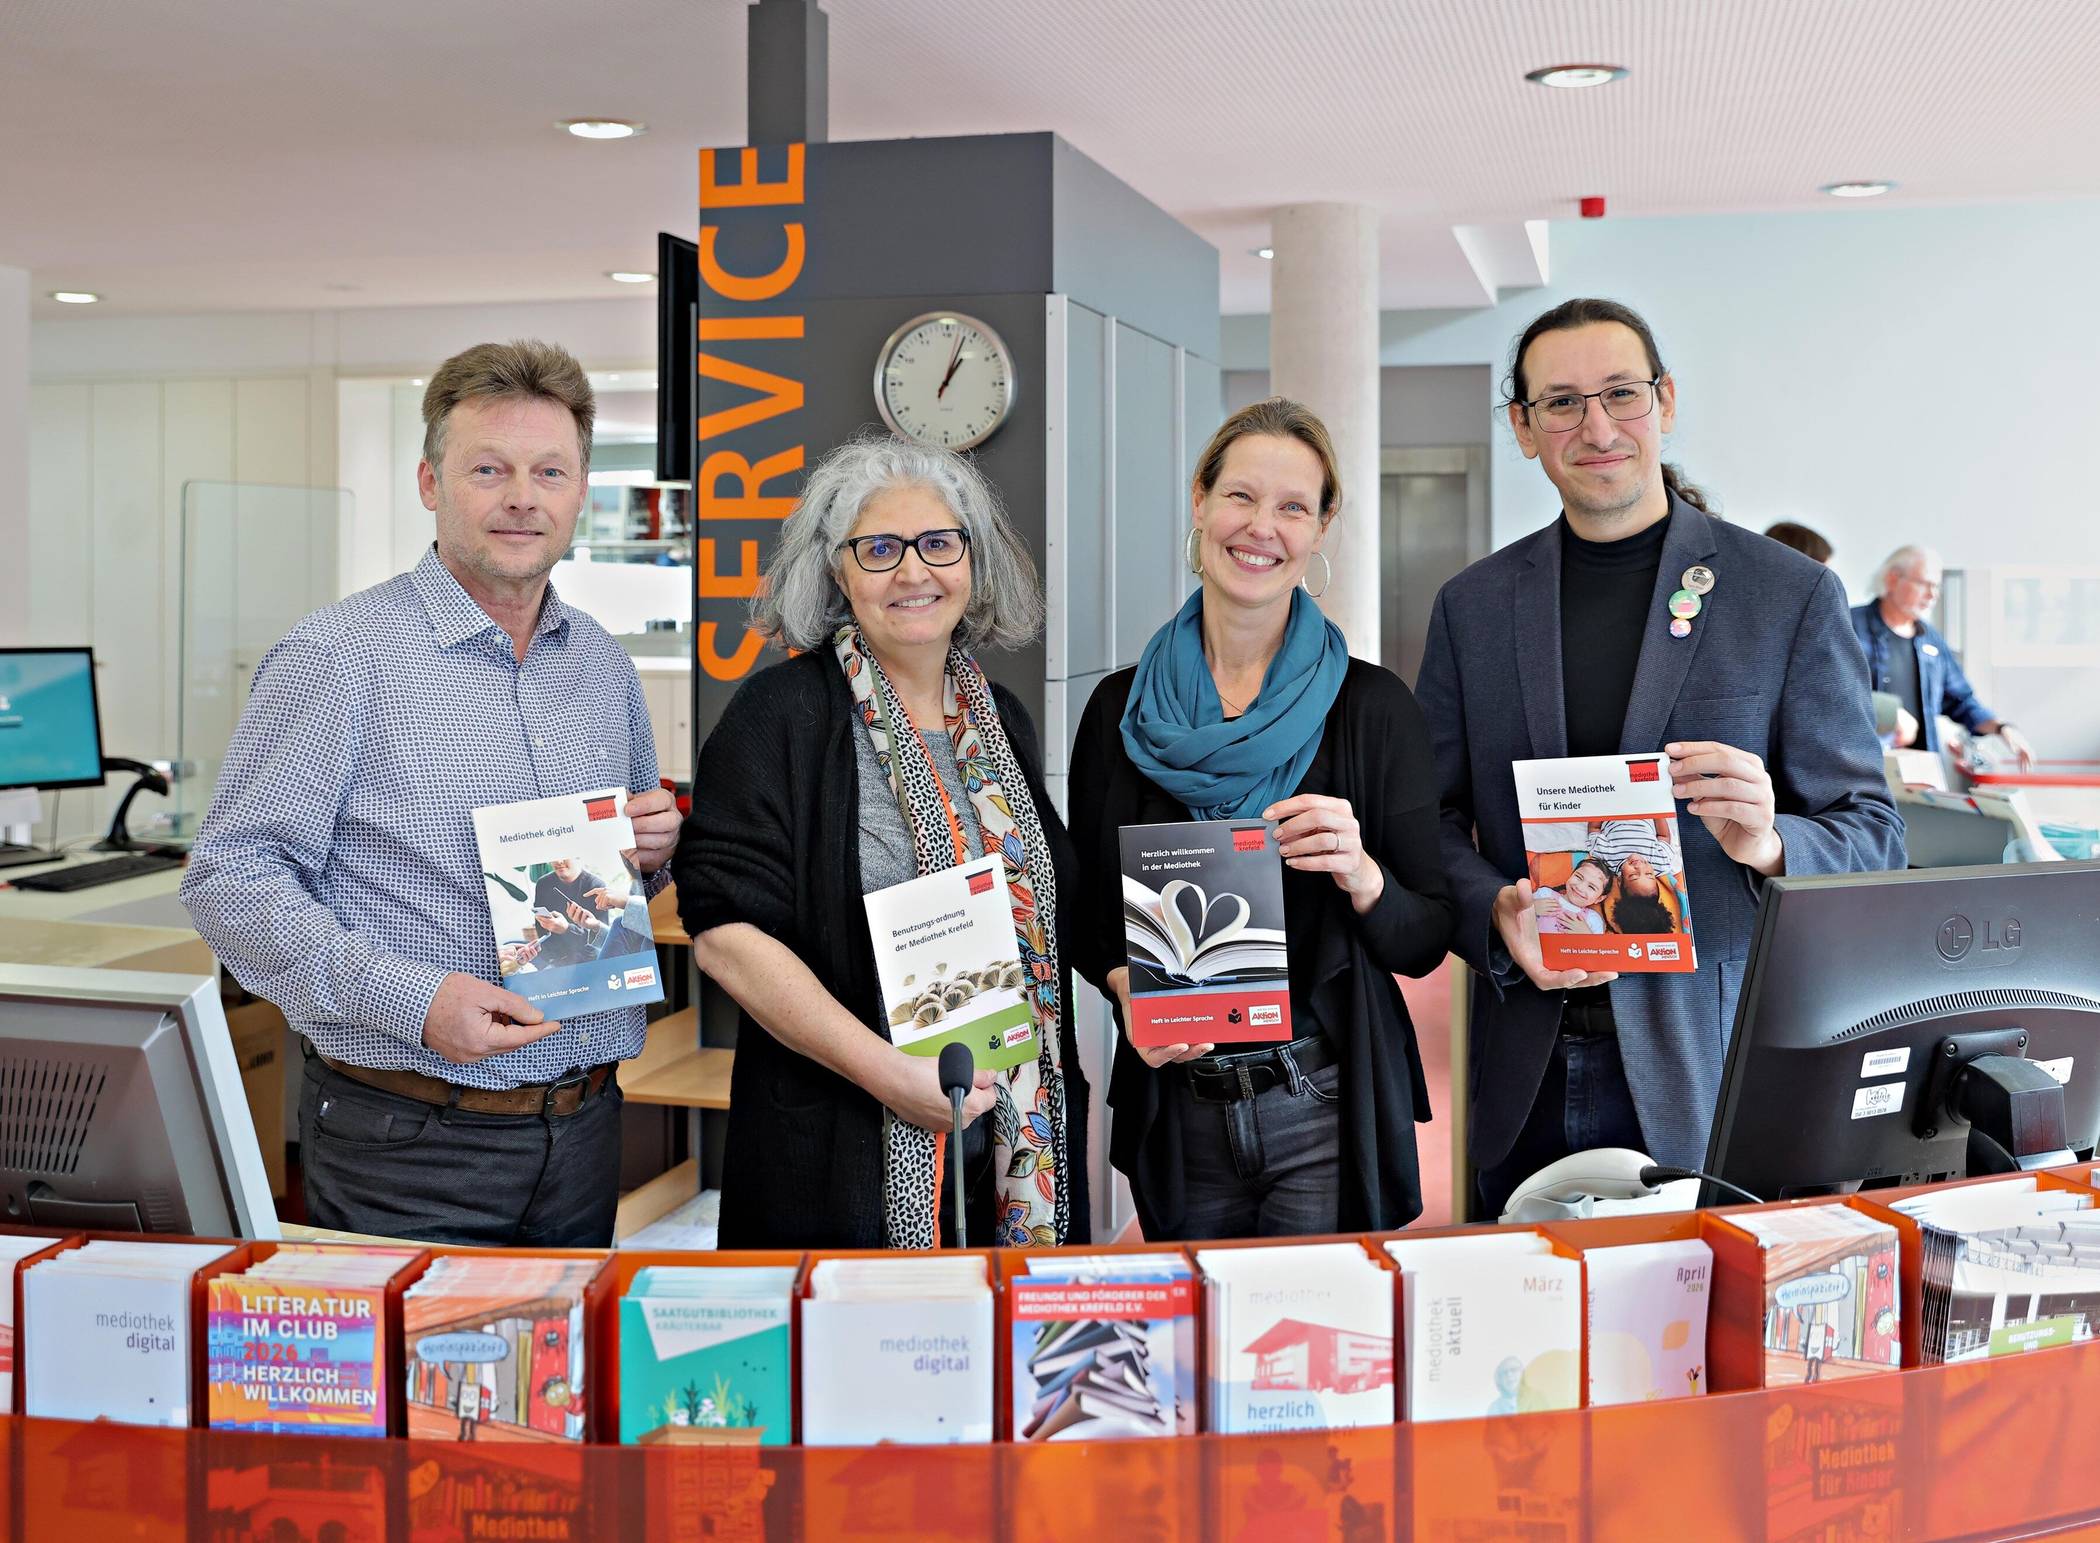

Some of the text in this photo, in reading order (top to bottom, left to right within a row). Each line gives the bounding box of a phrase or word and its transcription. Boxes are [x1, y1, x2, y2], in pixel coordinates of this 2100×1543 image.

[699, 143, 806, 681] SERVICE
[1536, 784, 1616, 796] Unsere Mediothek
[1538, 802, 1582, 811] für Kinder
[499, 825, 575, 844] Mediothek digital
[1141, 846, 1215, 858] Herzlich willkommen
[1142, 860, 1202, 871] in der Mediothek
[895, 920, 974, 952] der Mediothek Krefeld
[1982, 918, 2022, 951] LG
[1523, 1276, 1564, 1293] März
[1676, 1265, 1706, 1285] April
[1018, 1288, 1168, 1302] FREUNDE UND FÖRDERER DER
[241, 1295, 371, 1318] LITERATUR
[652, 1307, 778, 1319] SAATGUTBIBLIOTHEK
[1018, 1302, 1144, 1314] MEDIOTHEK KREFELD E.V.
[96, 1312, 175, 1332] mediothek
[242, 1318, 338, 1340] IM CLUB
[1446, 1296, 1462, 1356] aktuell
[126, 1332, 174, 1354] digital
[880, 1335, 970, 1352] mediothek
[1428, 1298, 1443, 1382] mediothek
[244, 1342, 298, 1362] 2026
[243, 1366, 340, 1384] HERZLICH
[913, 1355, 970, 1376] digital
[244, 1384, 377, 1406] WILLKOMMEN
[1247, 1401, 1315, 1420] herzlich
[1819, 1440, 1896, 1470] Mediothek
[1819, 1474, 1840, 1497] für
[472, 1514, 570, 1540] Mediothek
